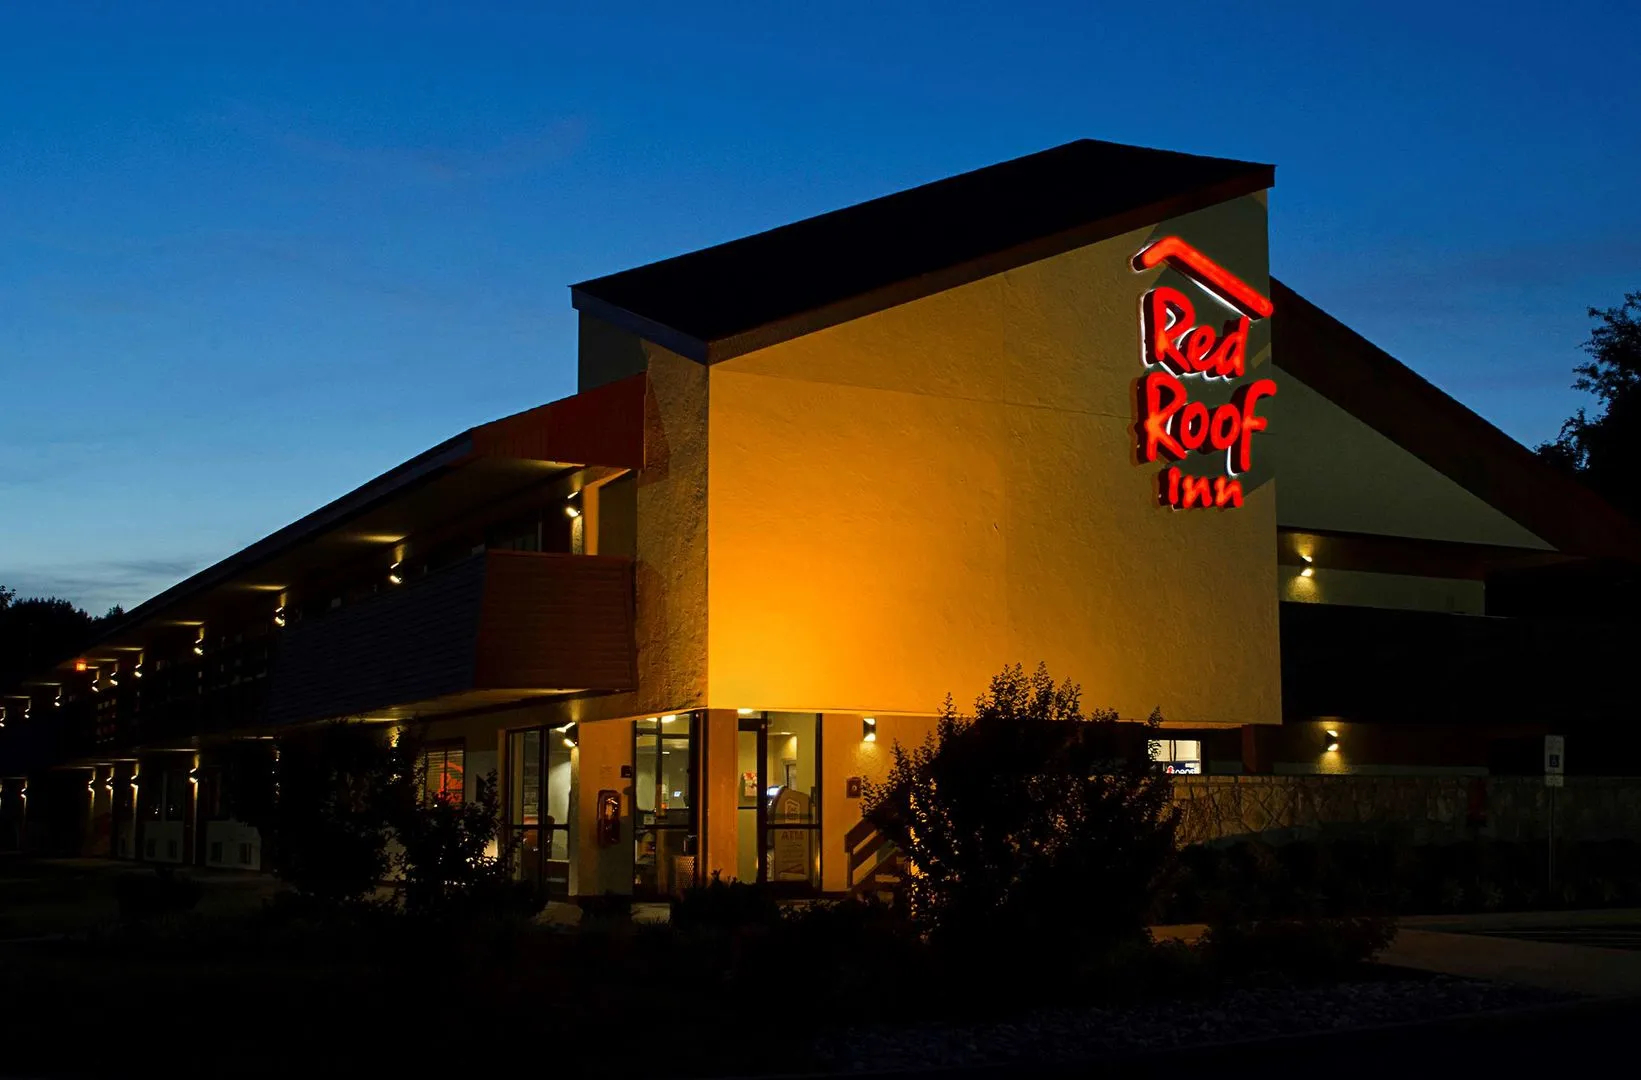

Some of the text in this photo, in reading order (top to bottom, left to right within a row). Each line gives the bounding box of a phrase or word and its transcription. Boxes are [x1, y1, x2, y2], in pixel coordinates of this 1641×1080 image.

[1152, 286, 1250, 377] Red
[1144, 371, 1277, 472] Roof
[1167, 466, 1243, 508] Inn
